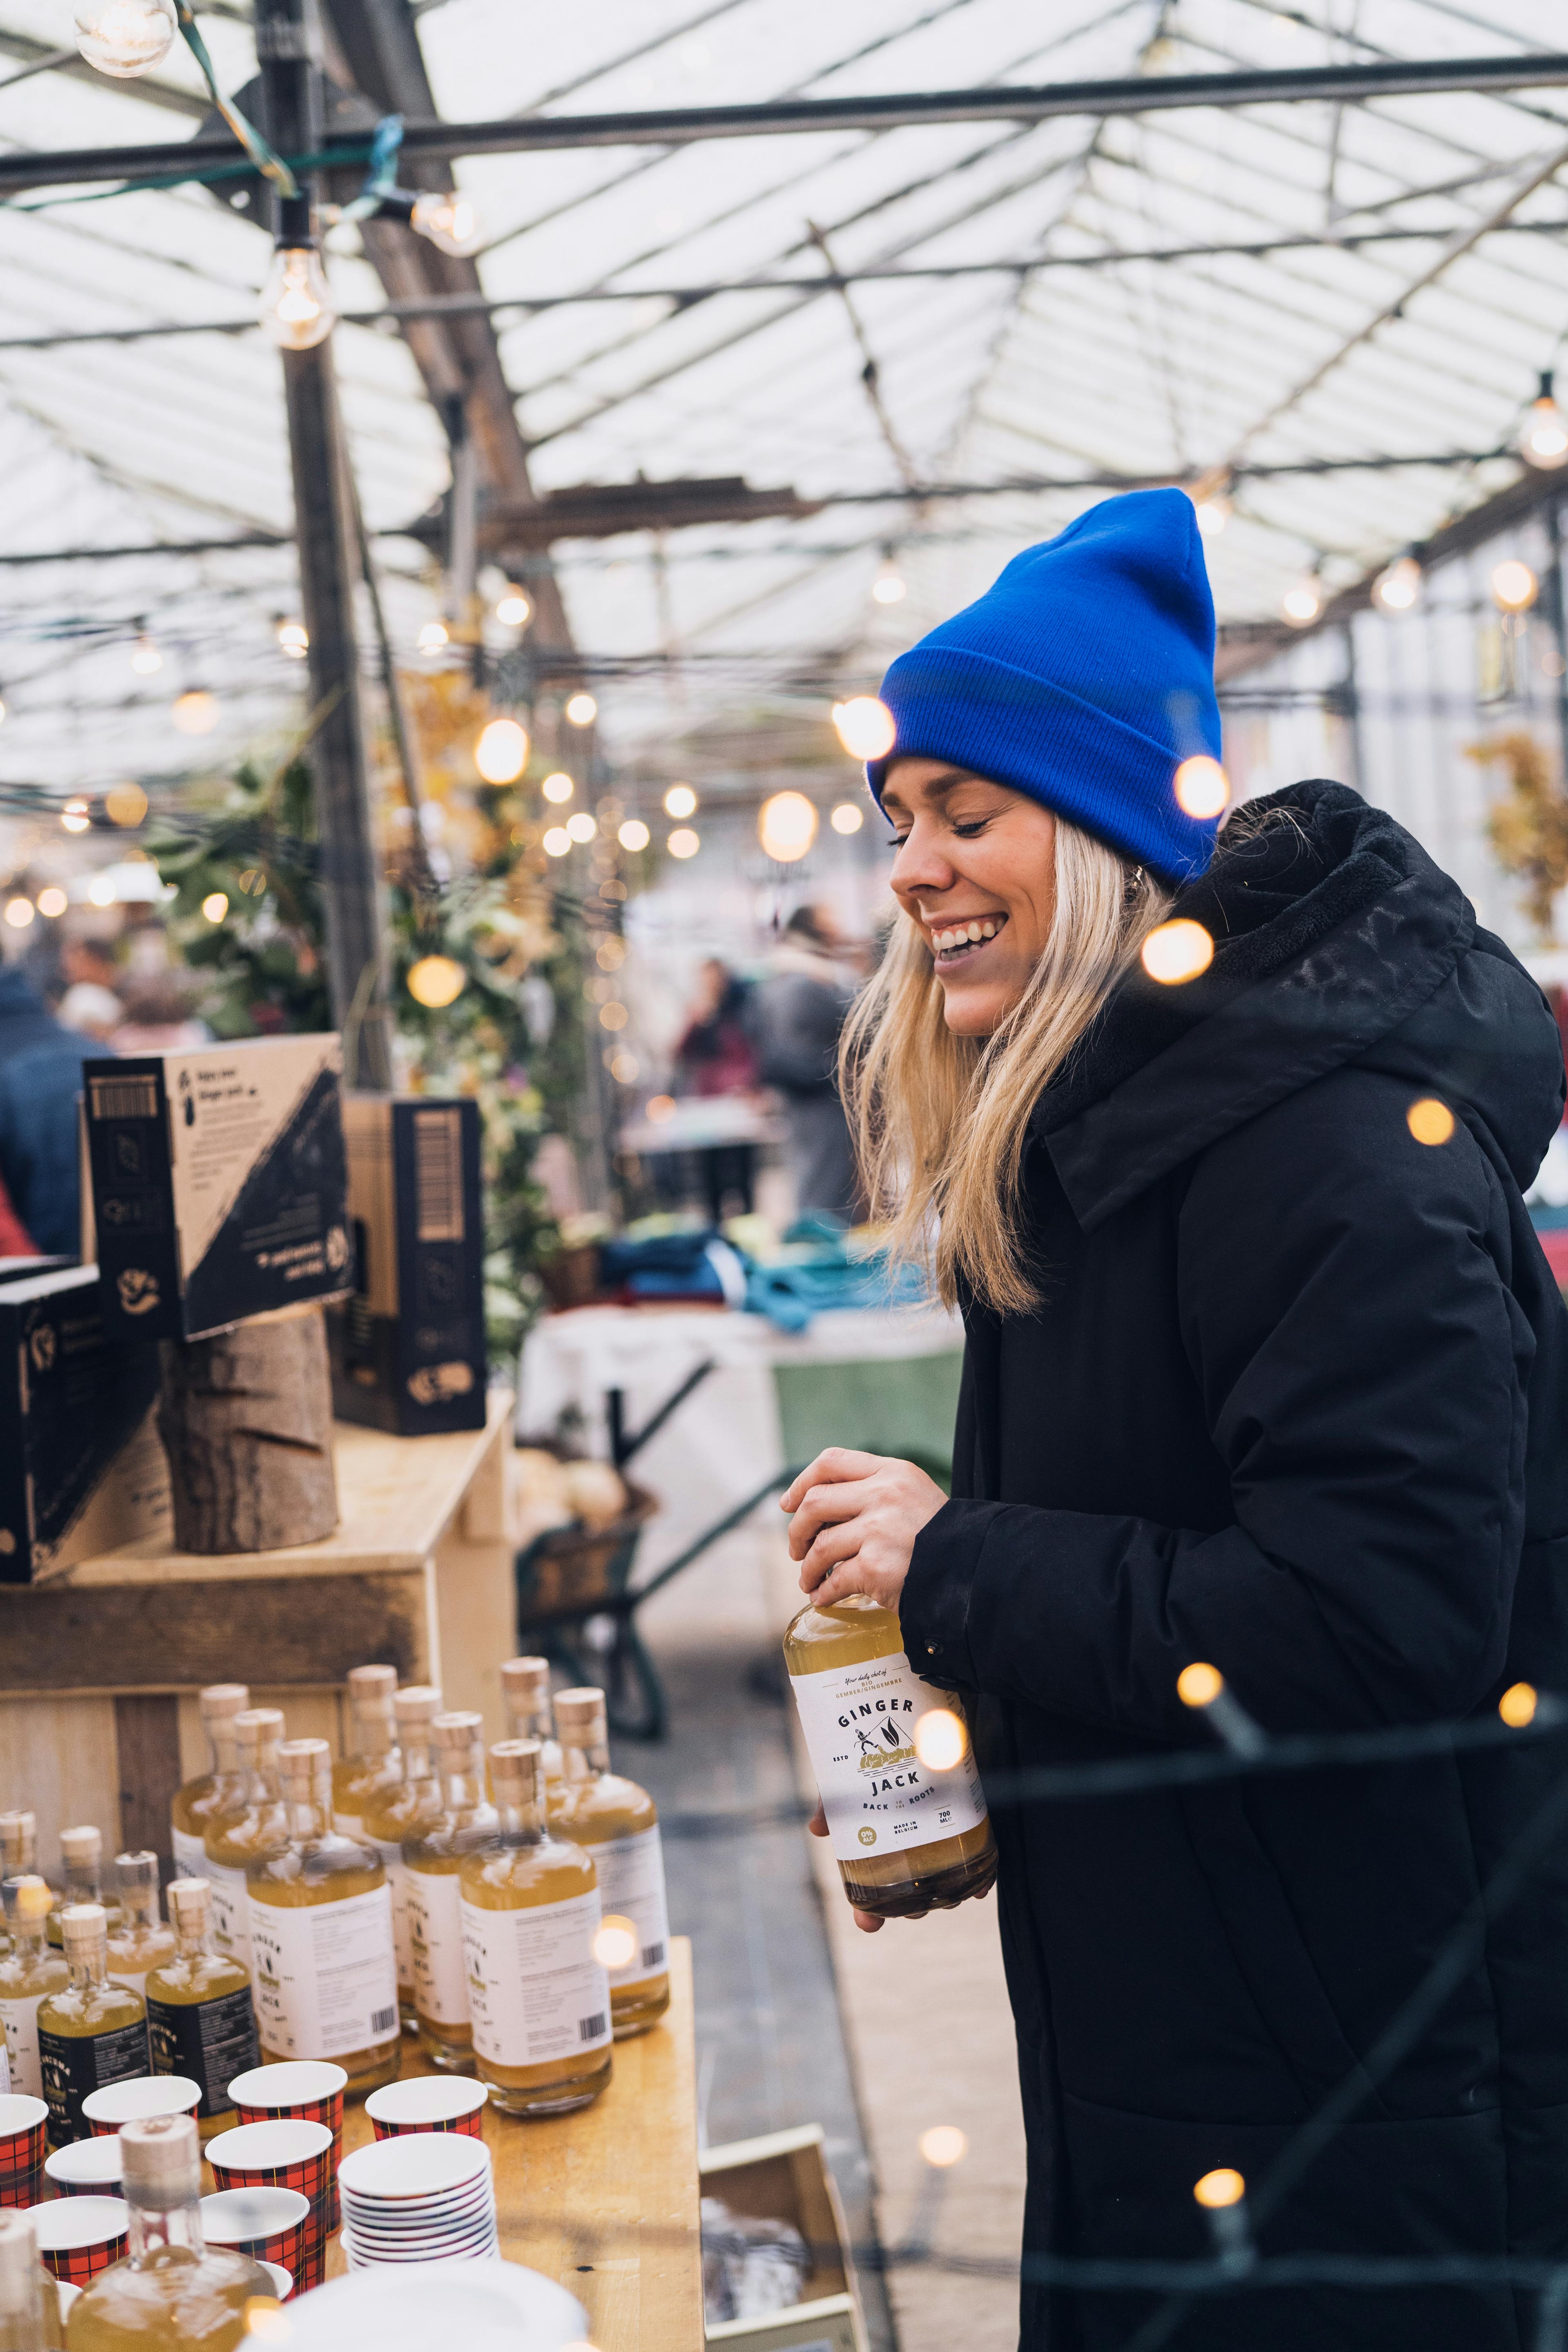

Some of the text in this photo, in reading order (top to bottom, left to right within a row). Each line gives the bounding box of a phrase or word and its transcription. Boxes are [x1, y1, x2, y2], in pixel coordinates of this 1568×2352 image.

[845, 1677, 857, 1685] Your
[881, 1668, 887, 1676] of
[835, 1677, 902, 1698] GEMBER/GINGEMBRE
[838, 1699, 913, 1727] GINGER
[872, 1771, 920, 1797] JACK
[909, 1786, 935, 1804] ROOTS
[895, 1825, 918, 1834] BELGIUM
